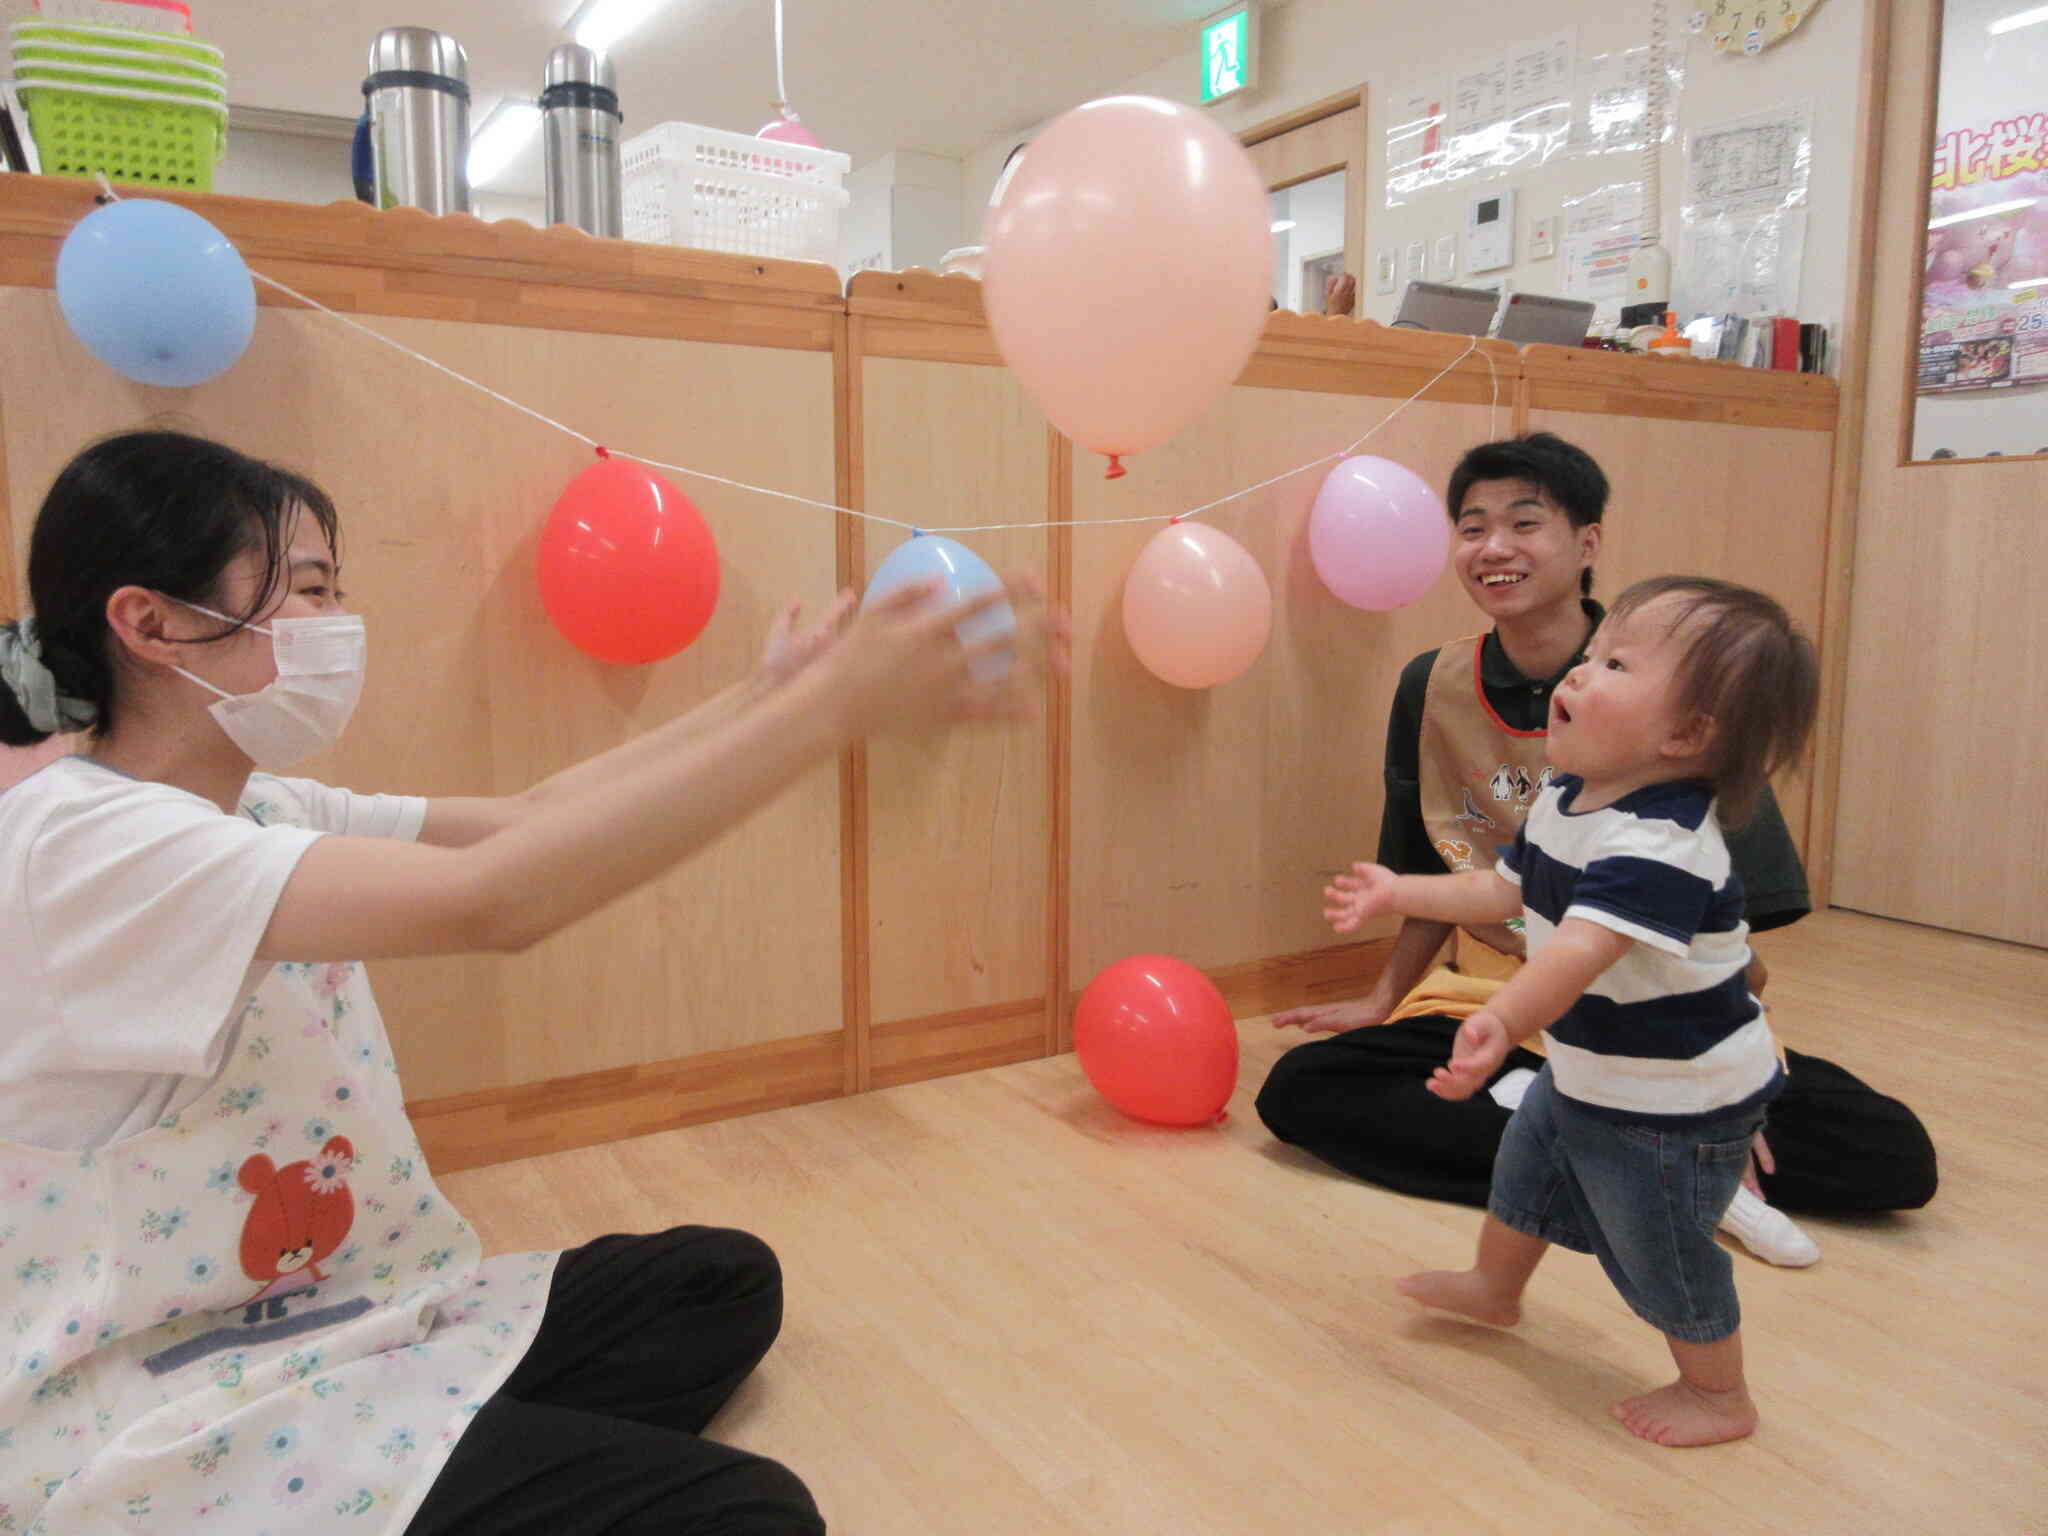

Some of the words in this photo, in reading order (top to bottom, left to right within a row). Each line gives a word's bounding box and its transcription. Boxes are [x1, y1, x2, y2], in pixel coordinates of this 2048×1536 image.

[1732, 11, 1742, 30] 7
[1755, 10, 1767, 29] 6
[1932, 112, 2048, 190] 北桜
